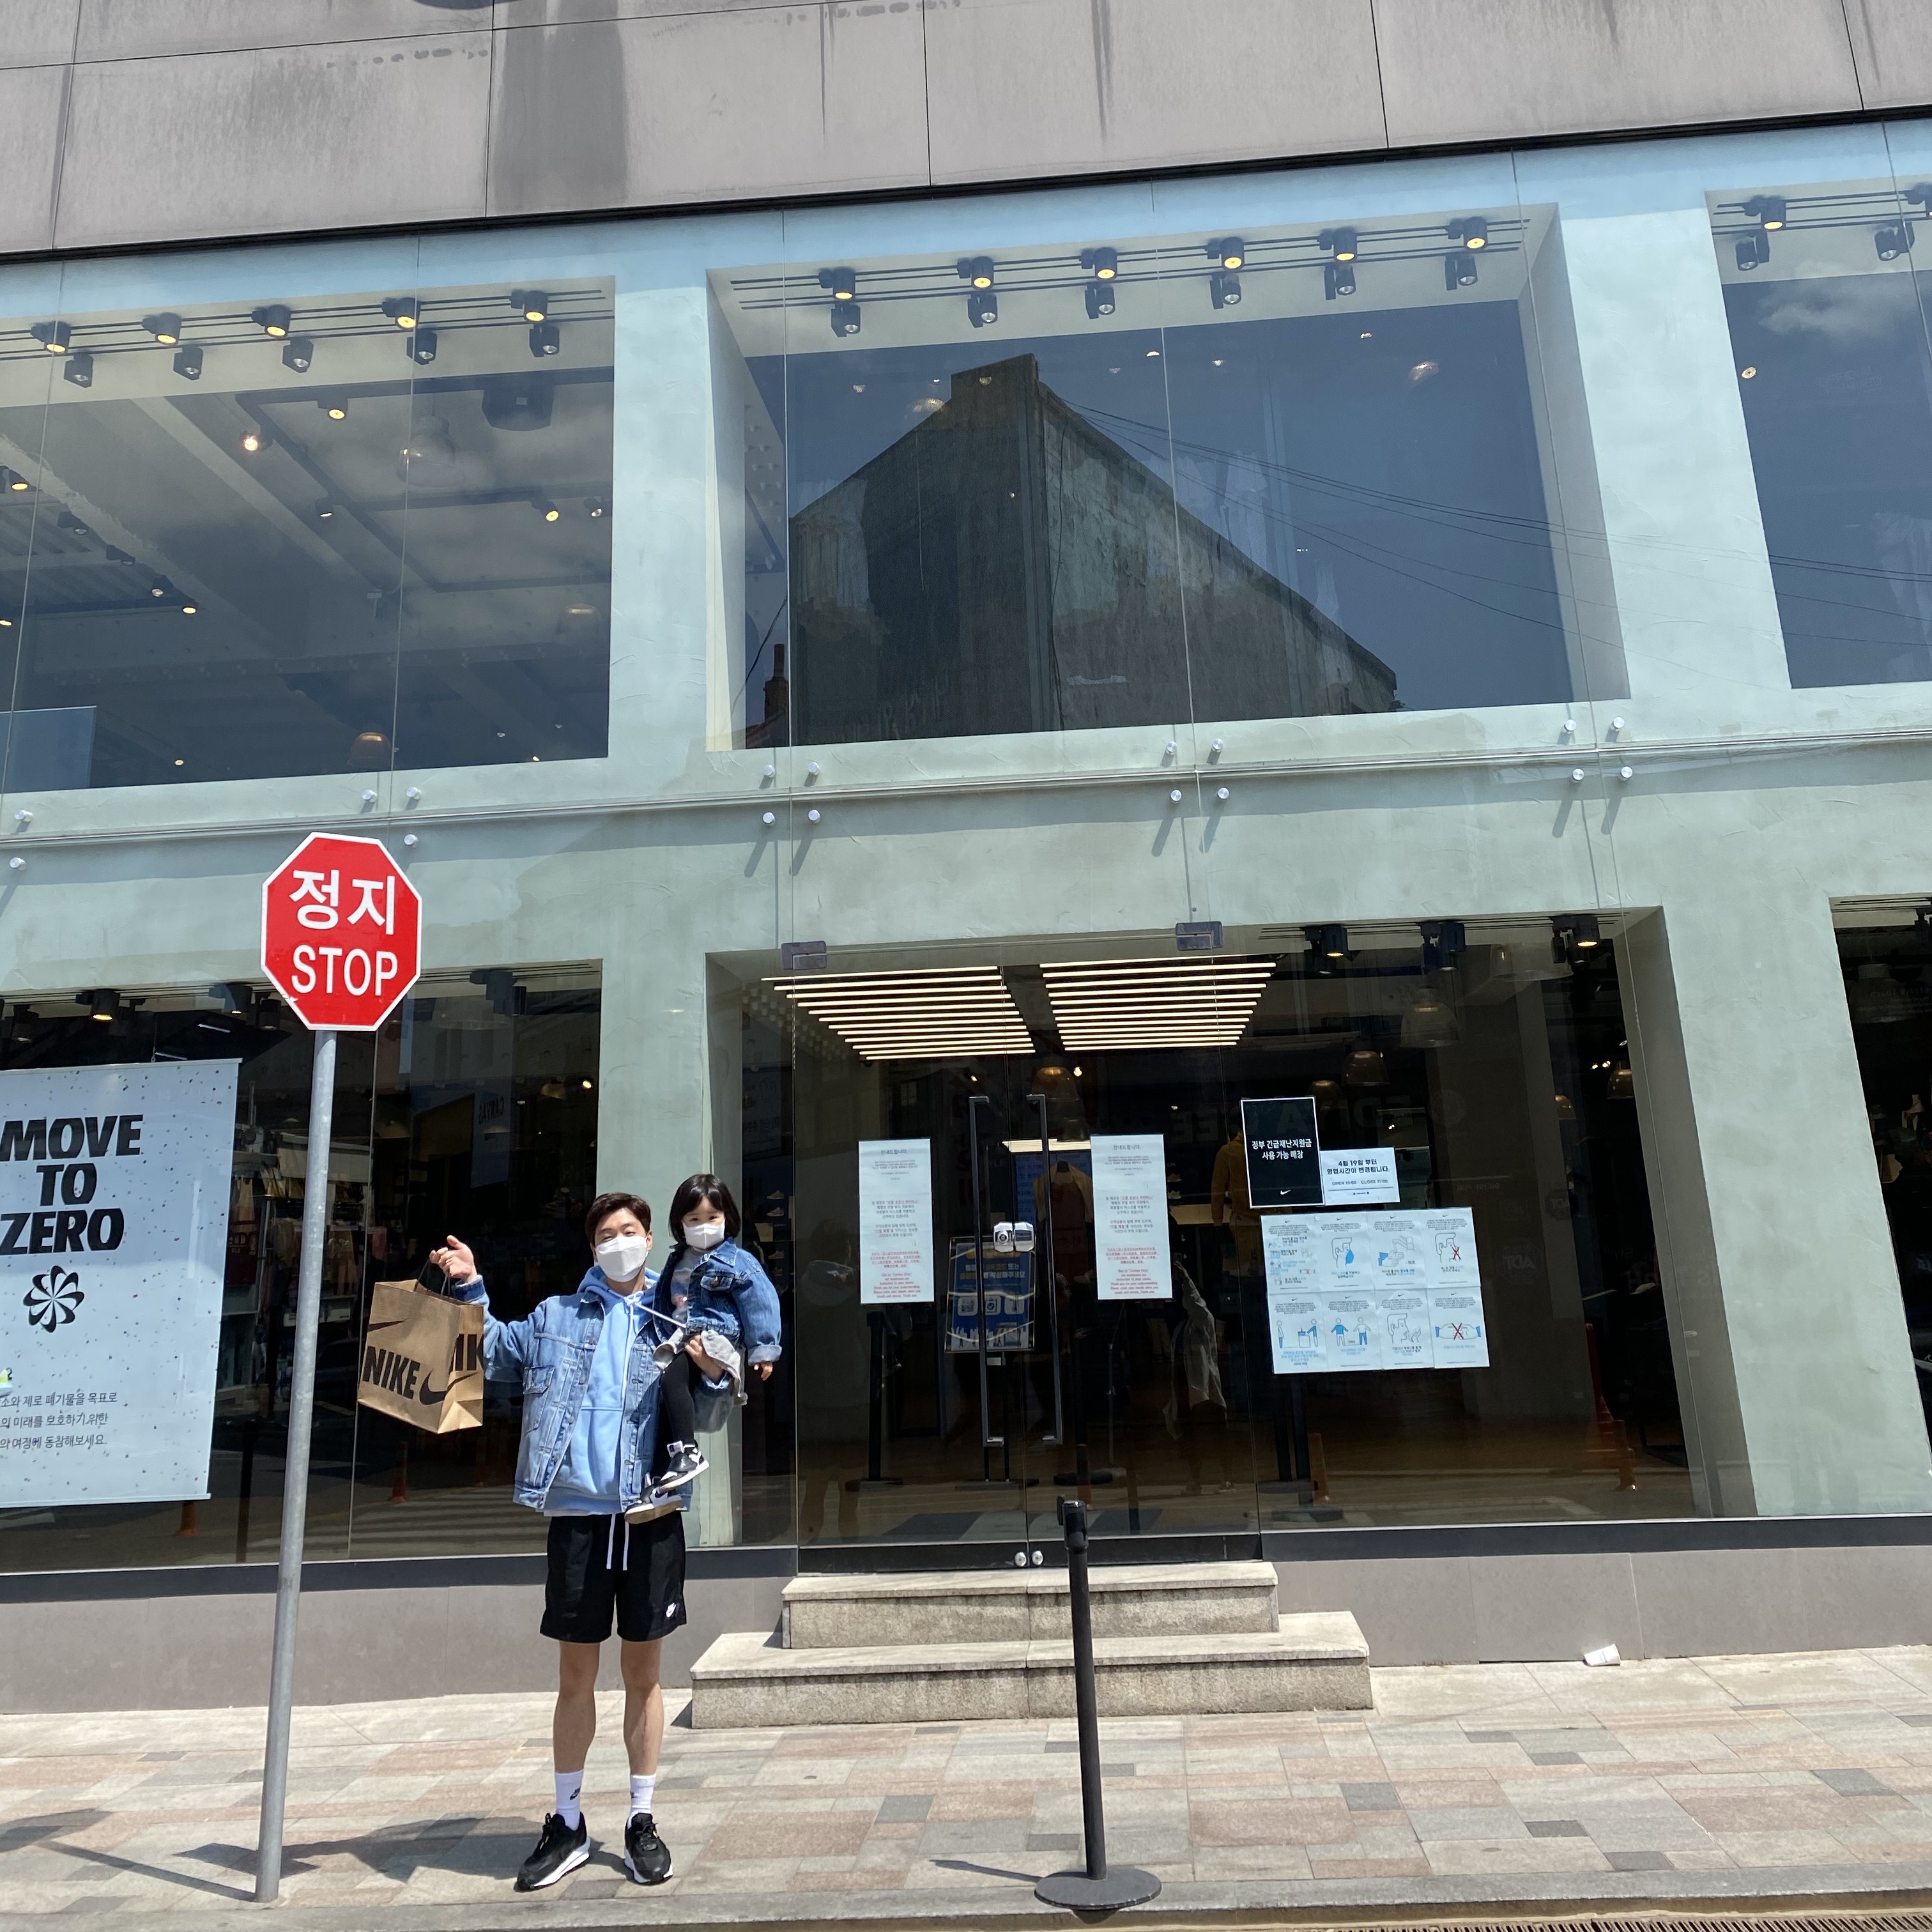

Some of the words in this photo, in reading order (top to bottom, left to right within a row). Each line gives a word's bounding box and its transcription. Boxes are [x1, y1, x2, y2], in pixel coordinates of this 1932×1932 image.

[289, 870, 395, 935] 정지
[291, 945, 397, 996] STOP
[0, 1115, 143, 1162] MOVE
[1252, 1141, 1265, 1149] 정부
[1266, 1139, 1312, 1149] 긴급재난지원금
[1262, 1151, 1275, 1160] 사용
[1276, 1151, 1289, 1160] 가능
[1290, 1150, 1303, 1159] 매장
[36, 1163, 97, 1206] TO
[0, 1208, 125, 1255] ZERO
[362, 1346, 420, 1400] NIKE
[13, 1415, 43, 1429] 미래를
[45, 1412, 86, 1426] 보호하기
[88, 1413, 108, 1426] 위한
[22, 1395, 43, 1407] 제로
[45, 1392, 86, 1406] 폐기물을
[88, 1392, 118, 1405] 목표로
[12, 1437, 42, 1450] 여정에
